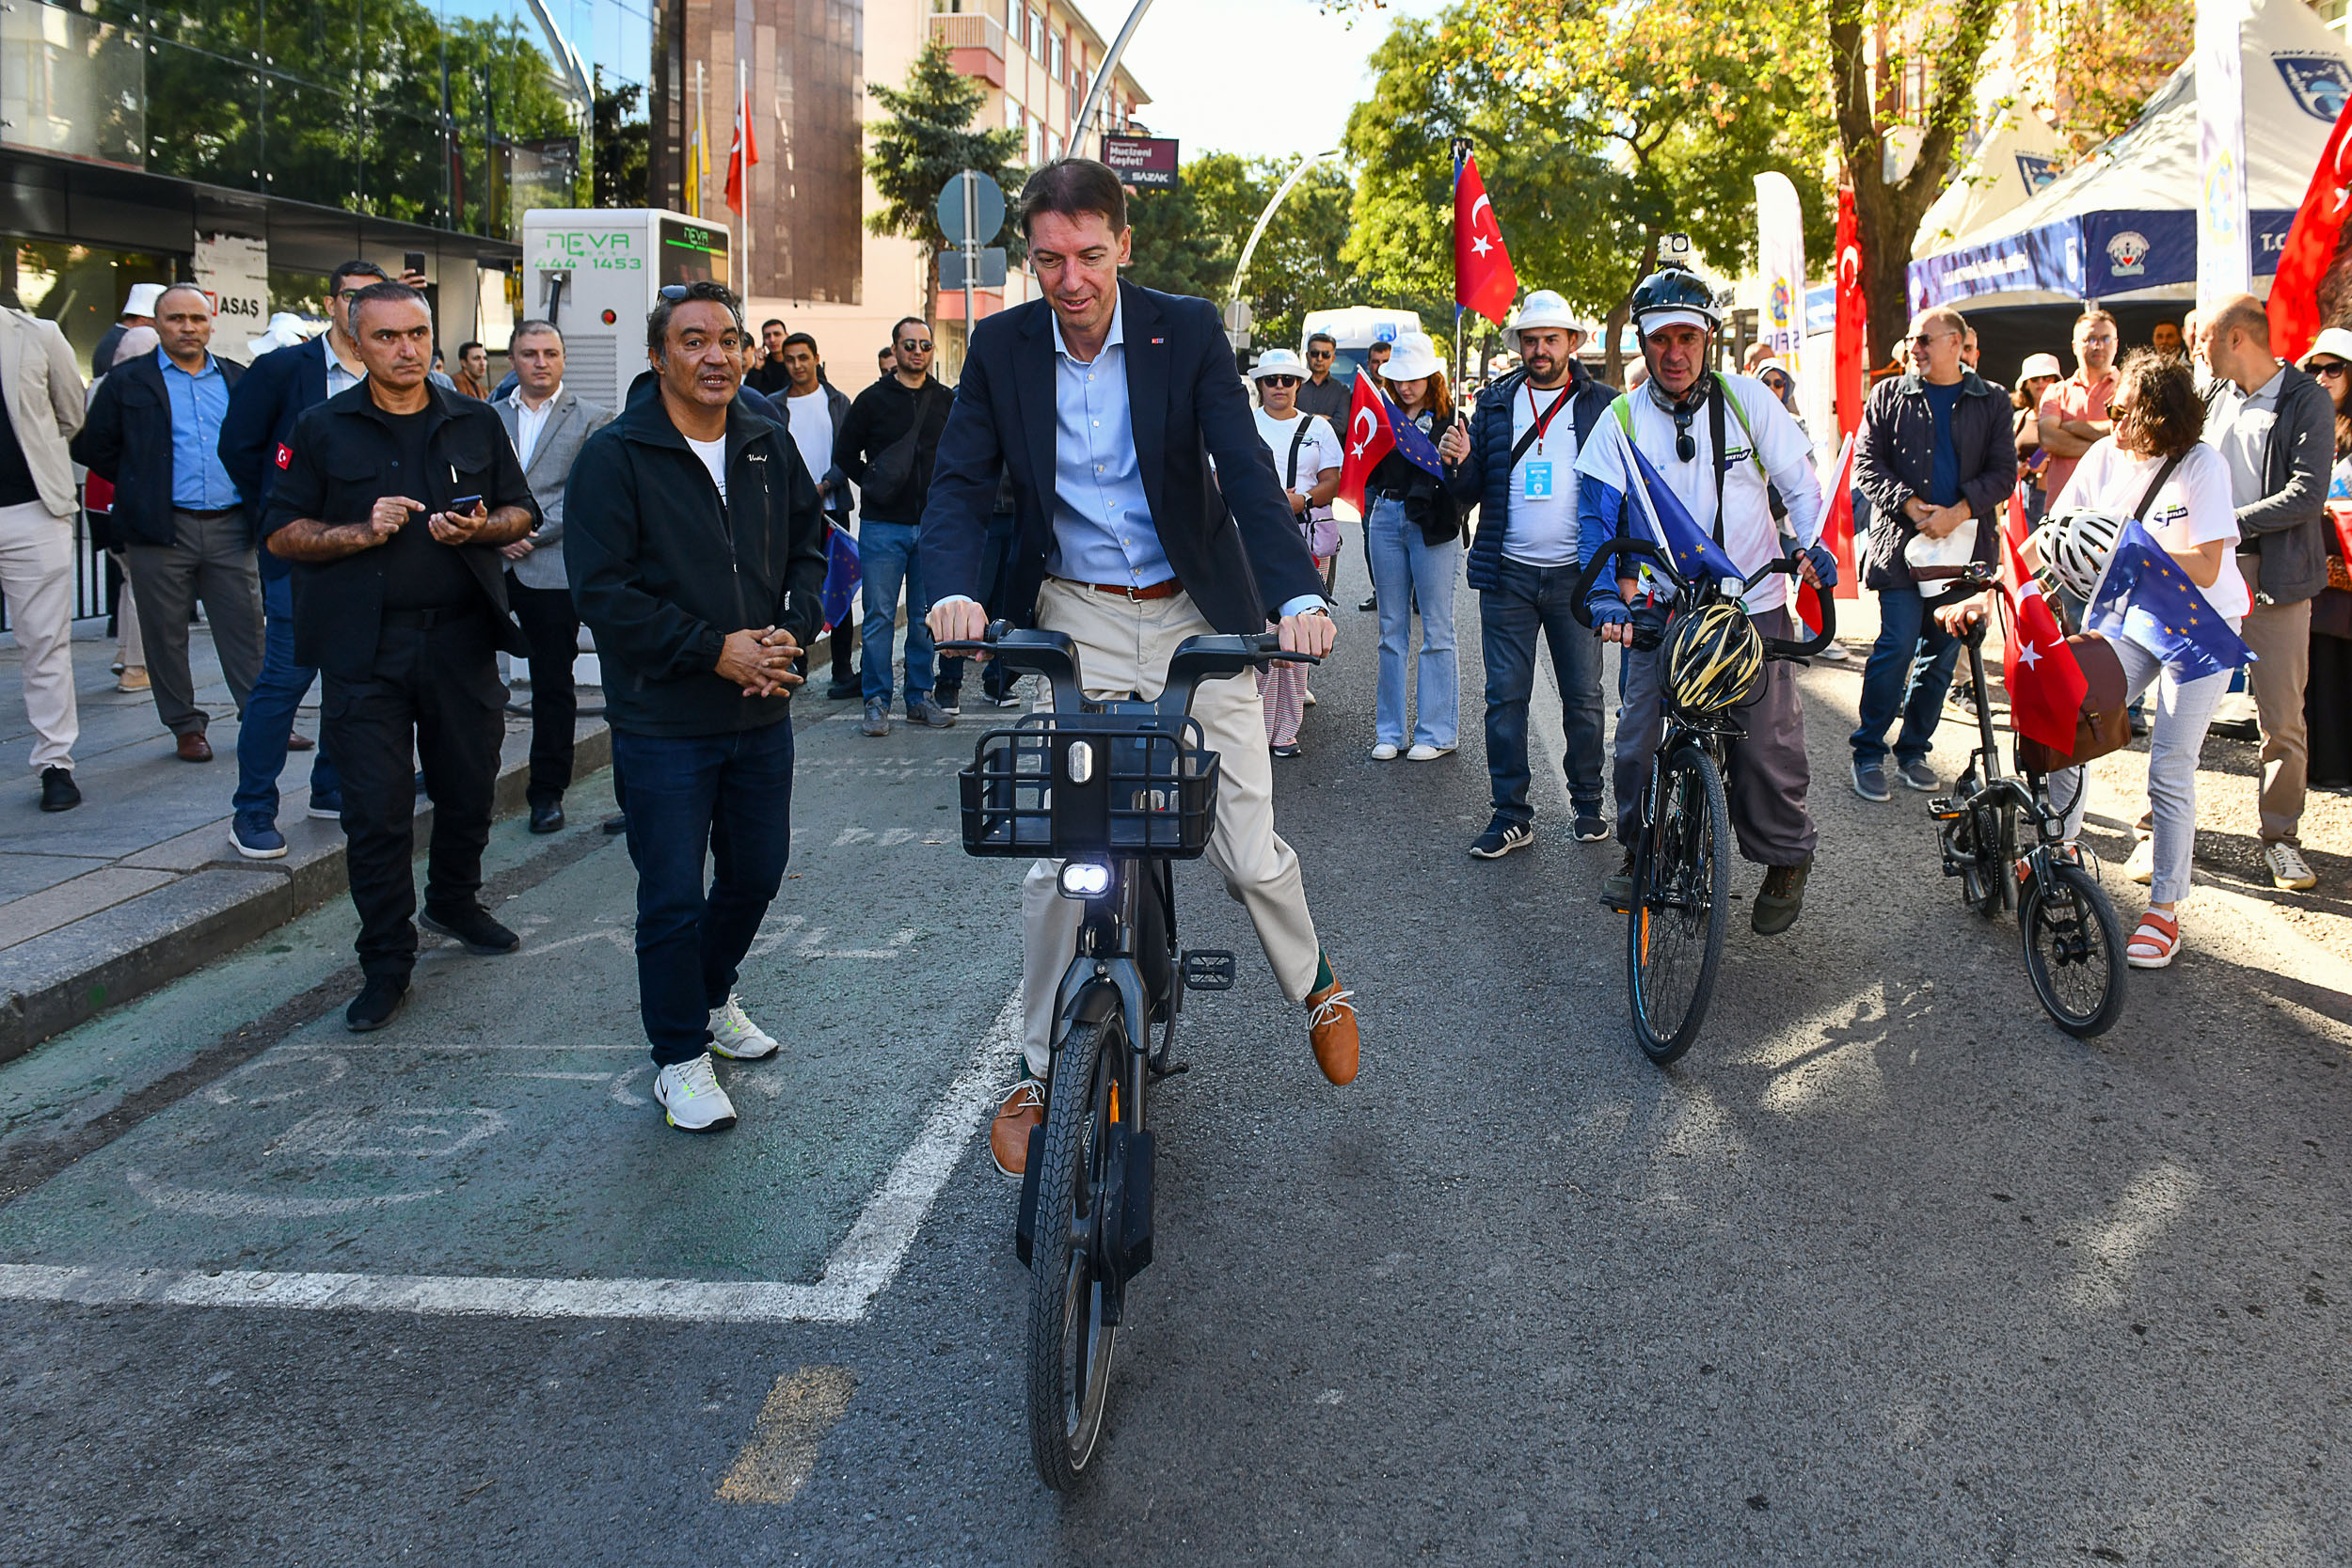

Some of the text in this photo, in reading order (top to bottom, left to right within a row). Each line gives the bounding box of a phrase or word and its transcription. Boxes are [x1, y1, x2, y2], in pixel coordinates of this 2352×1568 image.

[1109, 147, 1152, 158] Mucizeni
[1109, 155, 1143, 167] Keşfet!
[1132, 171, 1168, 182] SAZAK
[684, 227, 709, 245] NEVA
[547, 233, 629, 256] NEVA
[534, 258, 642, 270] 444 1453
[220, 296, 259, 318] ASAŞ
[1648, 753, 1659, 825] GEOTECH
